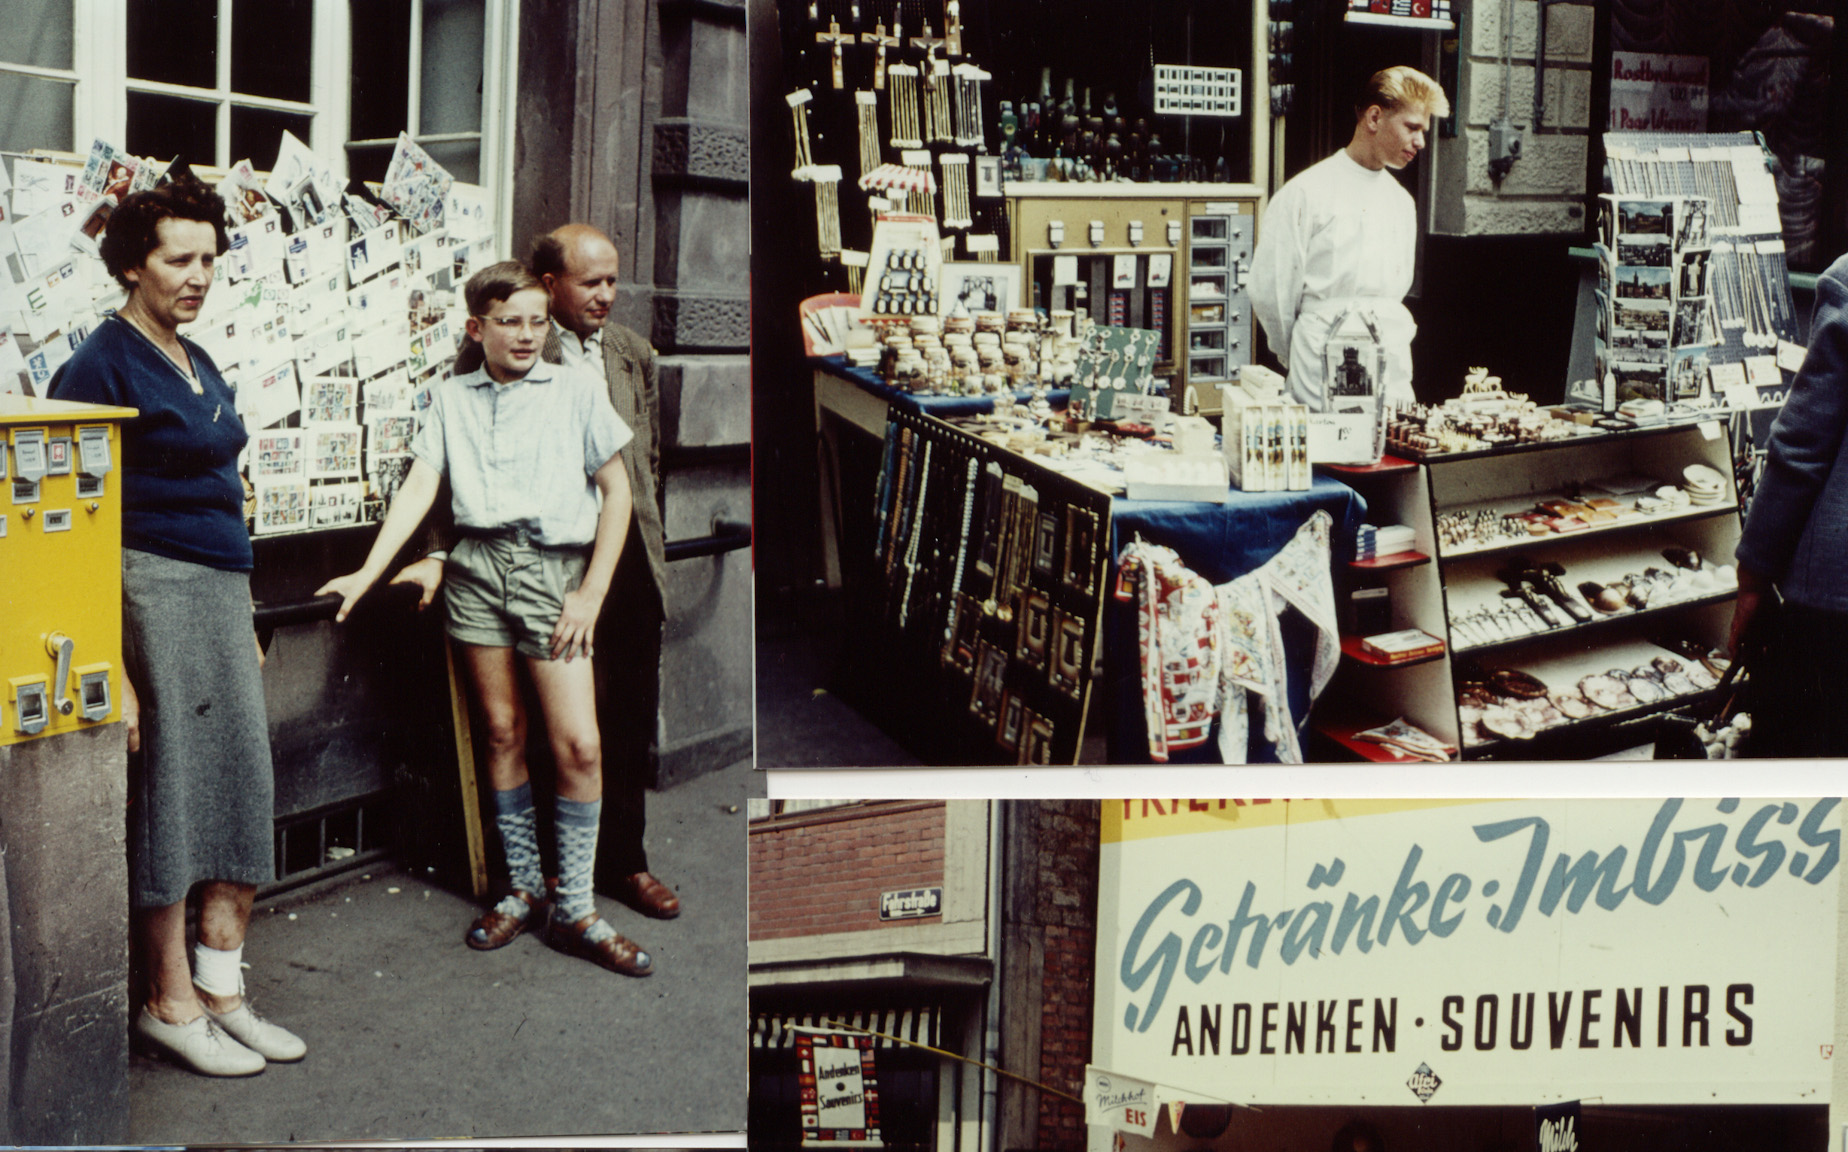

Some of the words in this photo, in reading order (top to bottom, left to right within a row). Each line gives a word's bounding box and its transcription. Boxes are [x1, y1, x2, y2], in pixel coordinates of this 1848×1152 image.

[1620, 107, 1650, 130] Paar
[1120, 844, 1472, 1033] Getränke
[1171, 998, 1397, 1056] ANDENKEN
[1441, 984, 1755, 1052] SOUVENIRS
[818, 1062, 860, 1080] Andenken
[819, 1091, 864, 1110] Souvenirs
[1097, 1088, 1146, 1108] Milchhof
[1125, 1107, 1147, 1127] EIS
